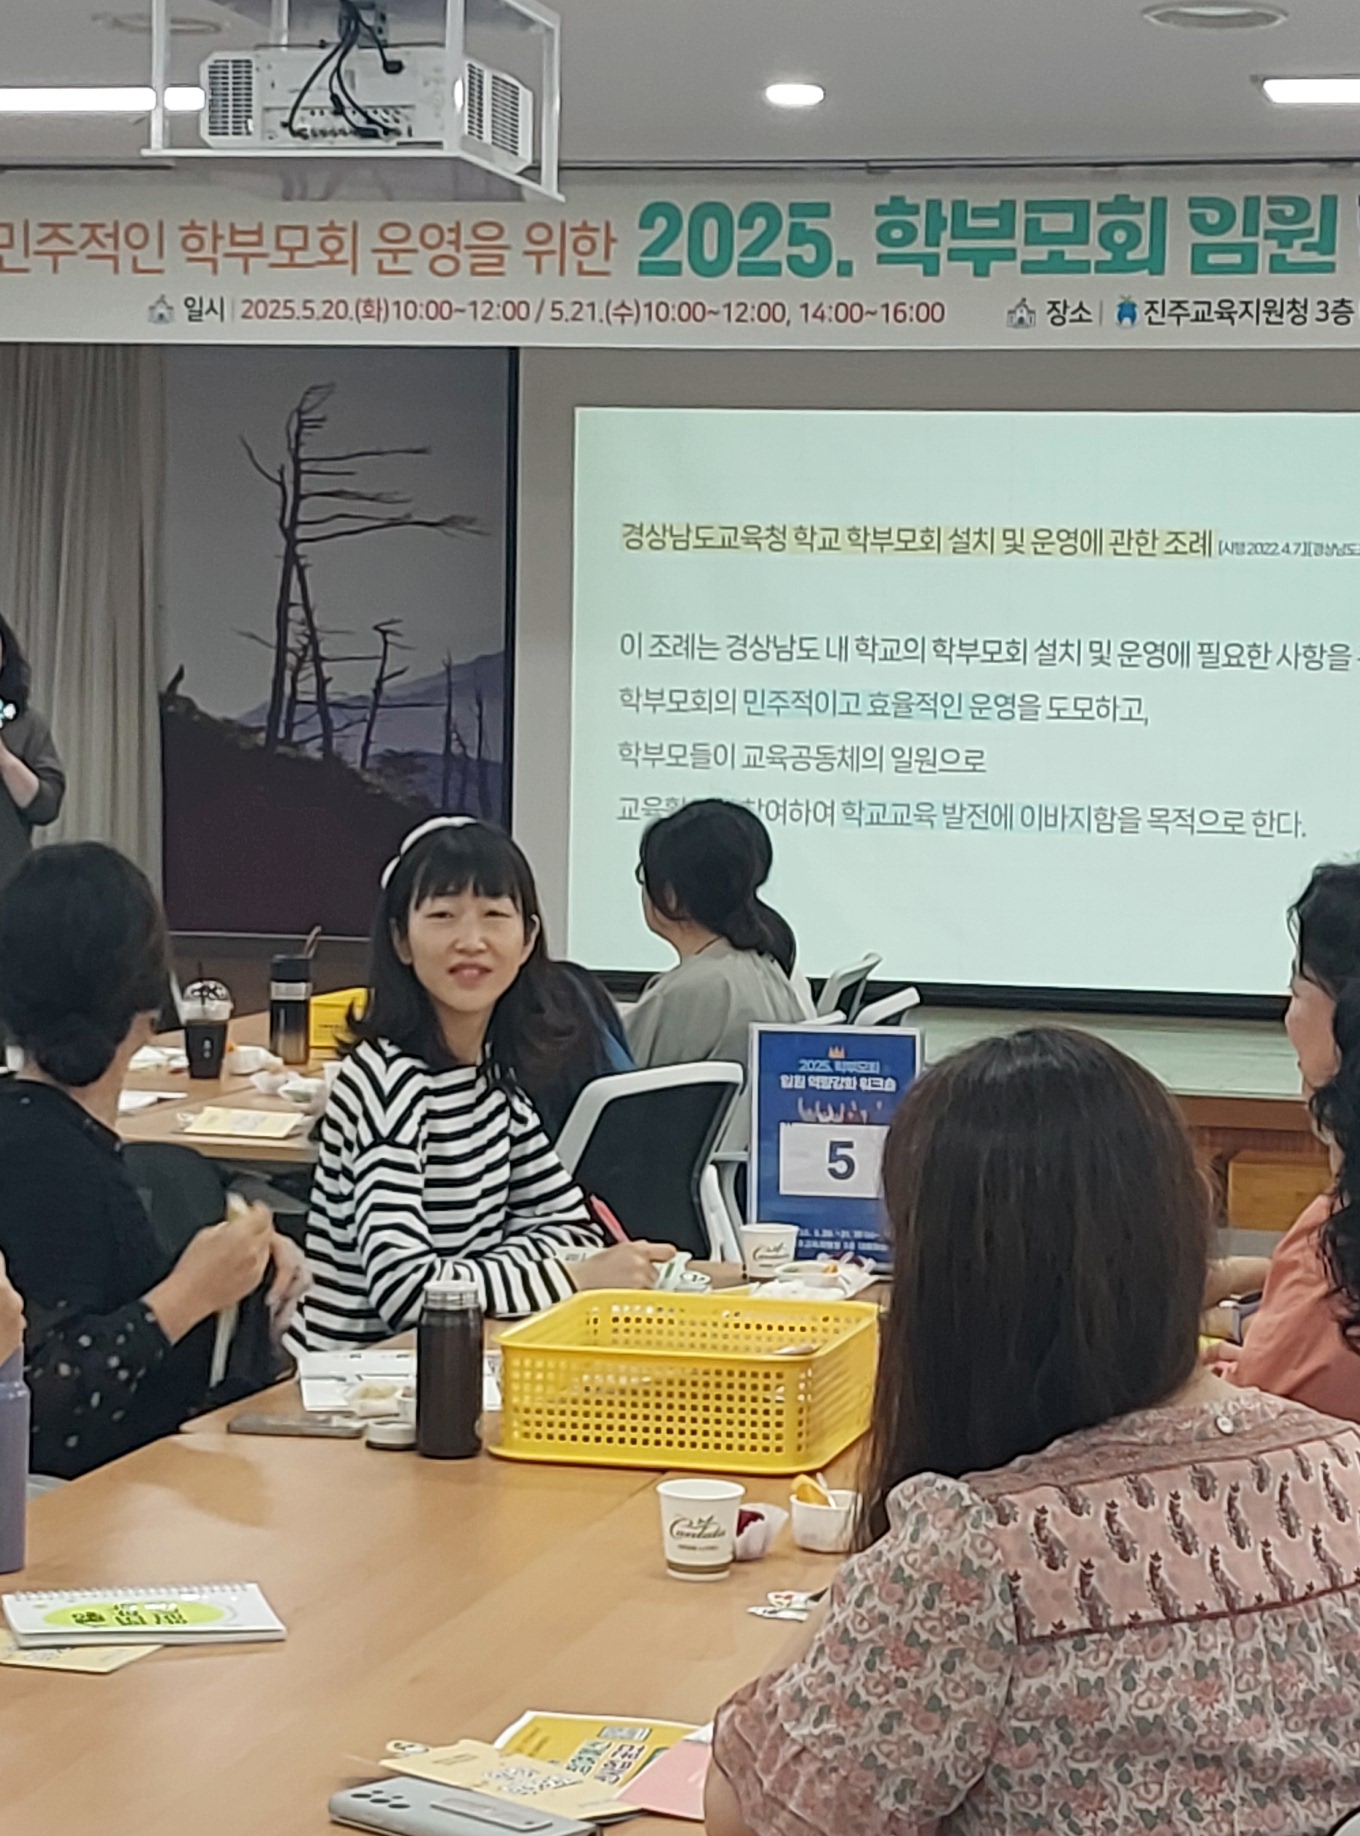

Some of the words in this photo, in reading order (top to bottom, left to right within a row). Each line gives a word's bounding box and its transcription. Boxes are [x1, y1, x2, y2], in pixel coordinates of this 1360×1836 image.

[177, 216, 361, 277] 학부모회
[369, 218, 514, 279] 운영을
[521, 217, 620, 279] 위한
[636, 199, 855, 280] 2025.
[873, 193, 1171, 279] 학부모회
[1186, 192, 1341, 277] 임원
[182, 294, 228, 325] 일시
[798, 300, 947, 326] 14:00~16:00
[1045, 297, 1095, 328] 장소
[1142, 297, 1311, 328] 진주교육지원청
[1313, 298, 1356, 327] 3층
[621, 521, 789, 556] 경상남도교육청
[792, 522, 842, 556] 학교
[845, 523, 943, 556] 학부모회
[946, 524, 997, 557] 설치
[1000, 526, 1027, 557] 및
[1029, 525, 1105, 558] 운영에
[1107, 526, 1161, 558] 관한
[1163, 527, 1215, 558] 조례
[619, 631, 644, 661] 이
[647, 632, 723, 662] 조례는
[725, 633, 822, 664] 경상남도
[824, 634, 851, 665] 내
[853, 634, 928, 666] 학교의
[930, 636, 1030, 668] 학부모회
[1032, 638, 1084, 668] 설치
[1086, 639, 1114, 669] 및
[1116, 640, 1193, 671] 운영에
[1195, 640, 1273, 672] 필요한
[1274, 641, 1355, 674] 사항을
[618, 686, 739, 717] 학부모회의
[741, 688, 864, 718] 민주적이고
[865, 690, 966, 720] 효율적인
[967, 692, 1042, 722] 운영을
[1043, 694, 1151, 726] 도모하고,
[616, 740, 738, 769] 학부모들이
[739, 742, 888, 774] 교육공동체의
[889, 745, 989, 776] 일원으로
[839, 798, 939, 830] 학교교육
[940, 802, 1016, 832] 발전에
[1018, 804, 1144, 835] 이바지함을
[1145, 806, 1250, 838] 목적으로
[1251, 810, 1310, 840] 한다.
[826, 1139, 856, 1181] 5
